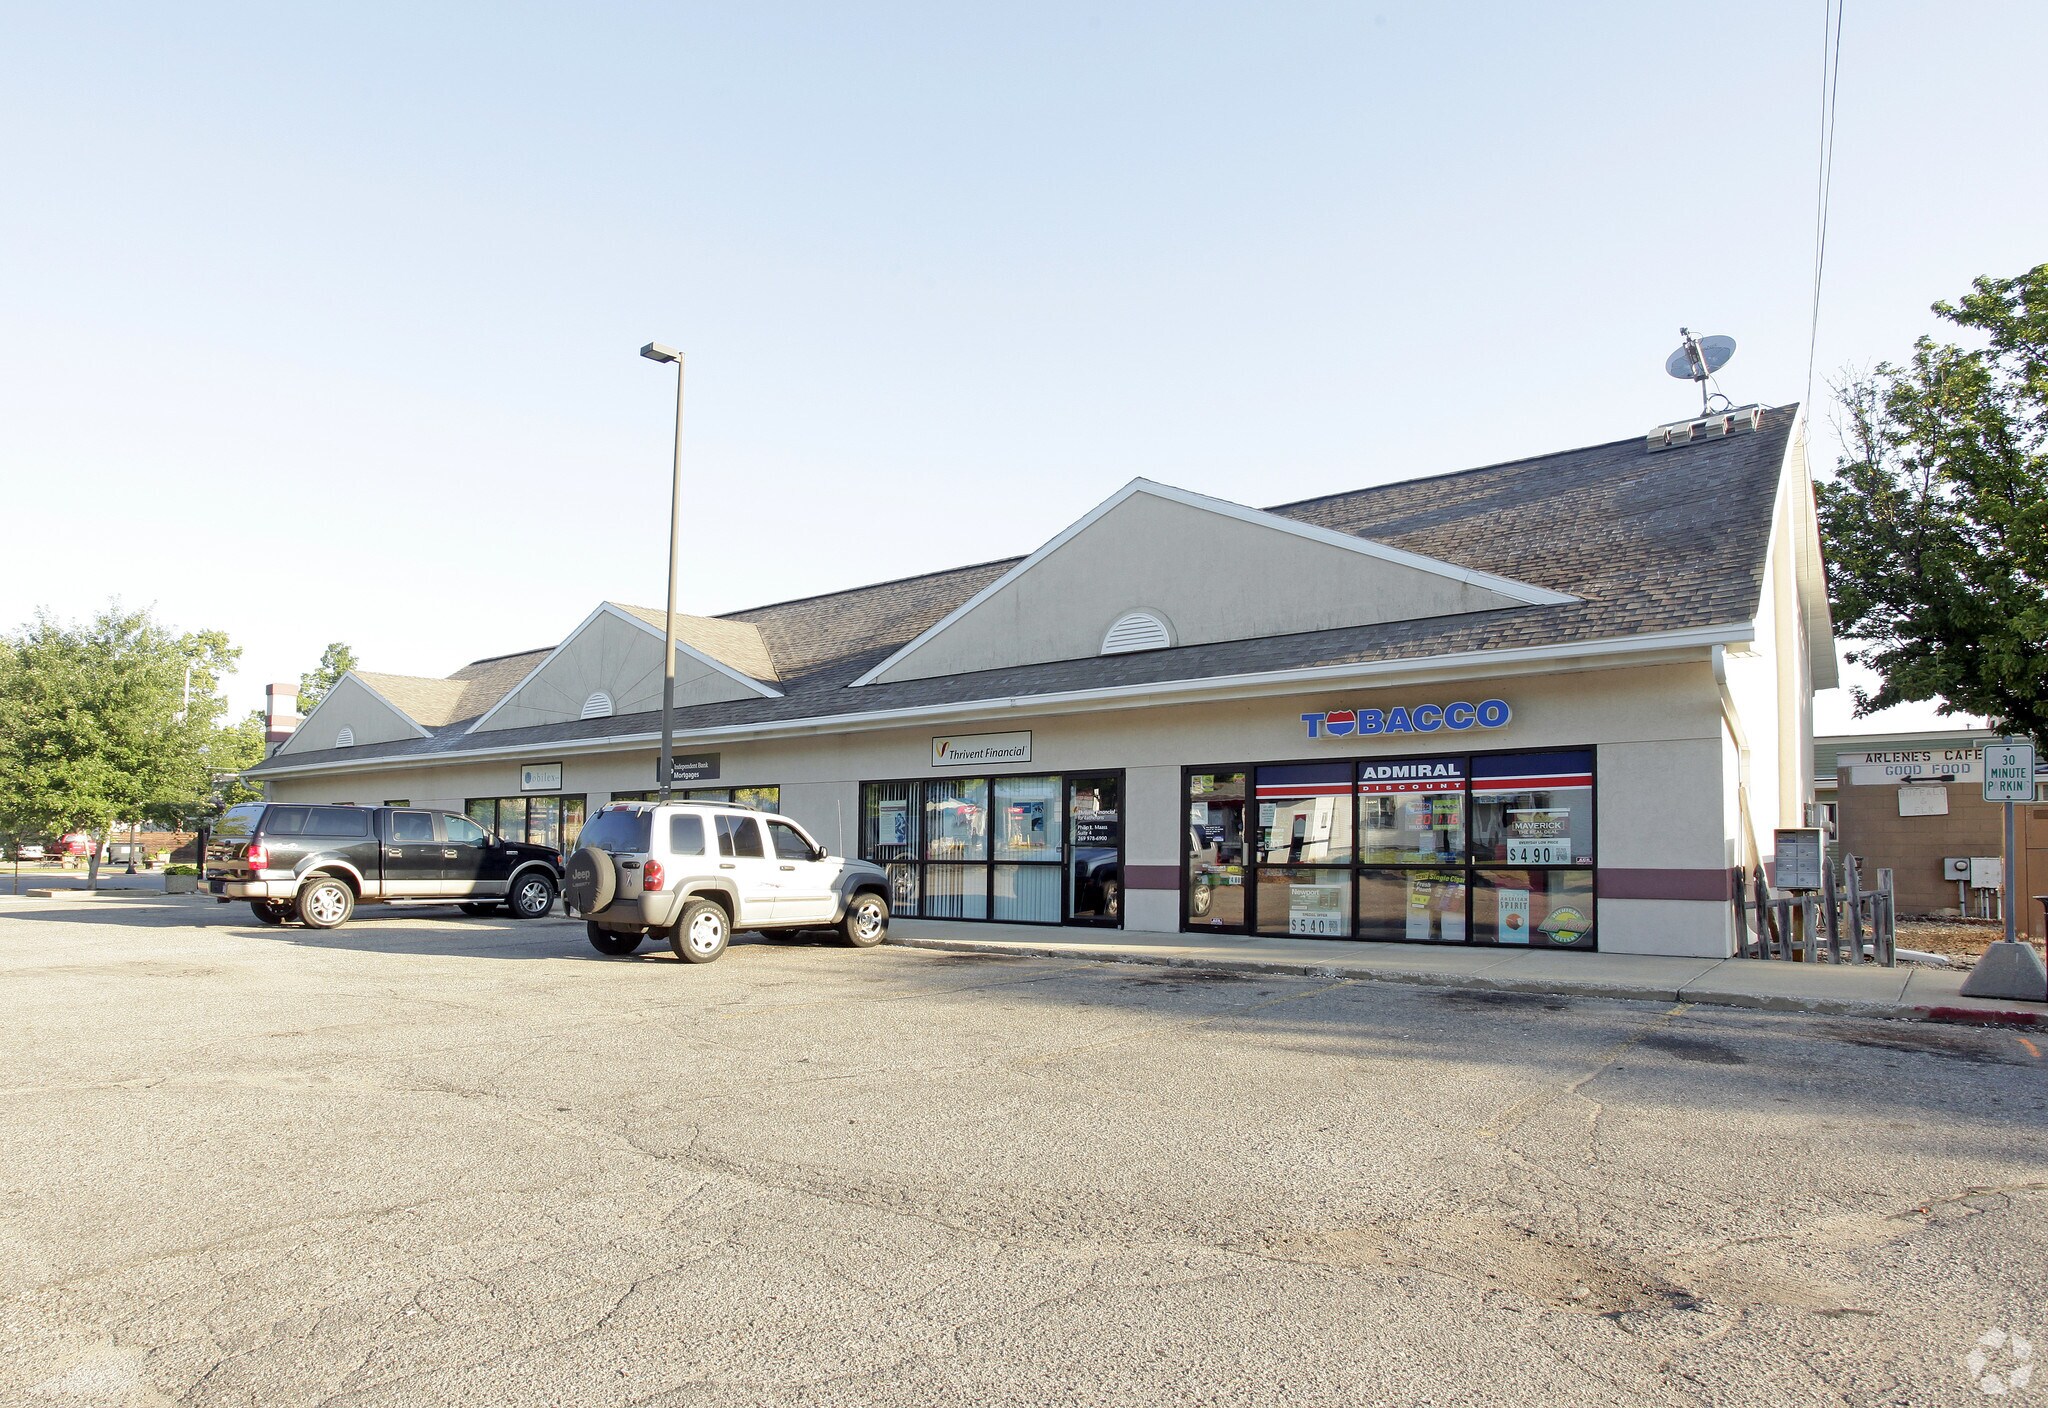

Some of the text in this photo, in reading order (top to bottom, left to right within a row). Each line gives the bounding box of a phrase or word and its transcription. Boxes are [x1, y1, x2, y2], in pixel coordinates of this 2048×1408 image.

[949, 745, 1025, 760] Thrivent Financial
[1865, 749, 1982, 763] ARLENE'S CAFE
[674, 761, 709, 770] Independent Bank
[2002, 754, 2015, 766] 30
[673, 771, 700, 780] Mortgages
[1362, 763, 1461, 779] ADMIRAL
[1885, 763, 1971, 776] GOOD FOOD
[1991, 767, 2027, 779] MINUTE
[1362, 782, 1461, 791] DISCOUNT
[1987, 780, 2030, 792] PRKIN
[1514, 822, 1562, 830] MAVERICK
[572, 868, 591, 880] Jeep
[1291, 888, 1319, 897] Newport
[1500, 902, 1528, 910] SPIRIT
